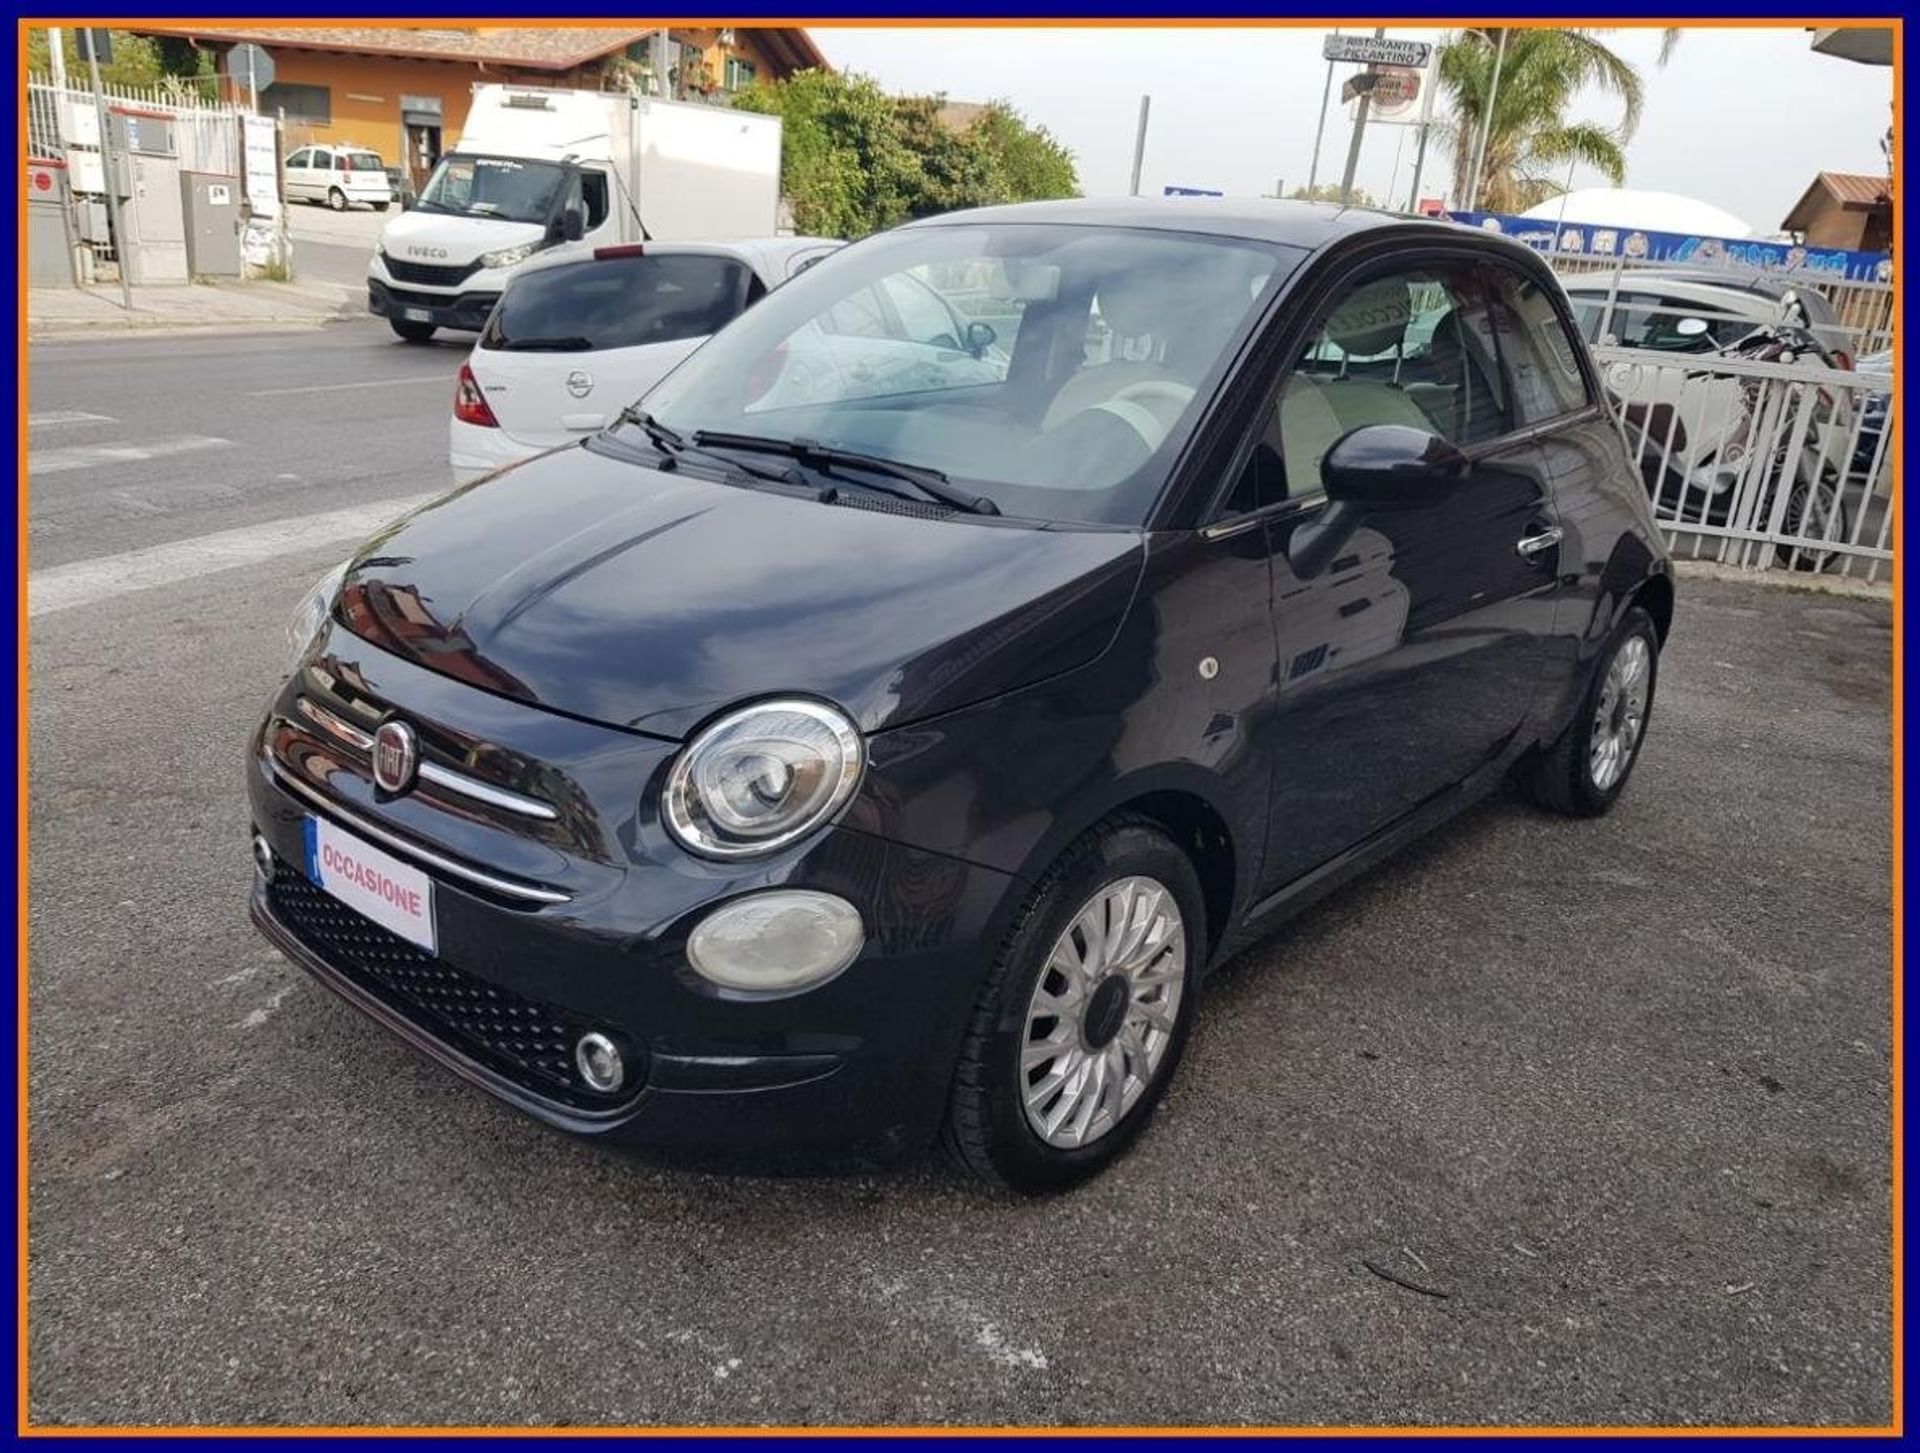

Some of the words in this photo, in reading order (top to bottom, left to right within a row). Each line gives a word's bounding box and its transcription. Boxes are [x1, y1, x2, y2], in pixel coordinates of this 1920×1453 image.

[1346, 37, 1413, 51] RISTORANTE
[1344, 48, 1414, 63] PICCANTINO
[407, 245, 448, 259] IVECO
[380, 741, 402, 777] FIAT
[323, 844, 421, 918] OCCASIONE
